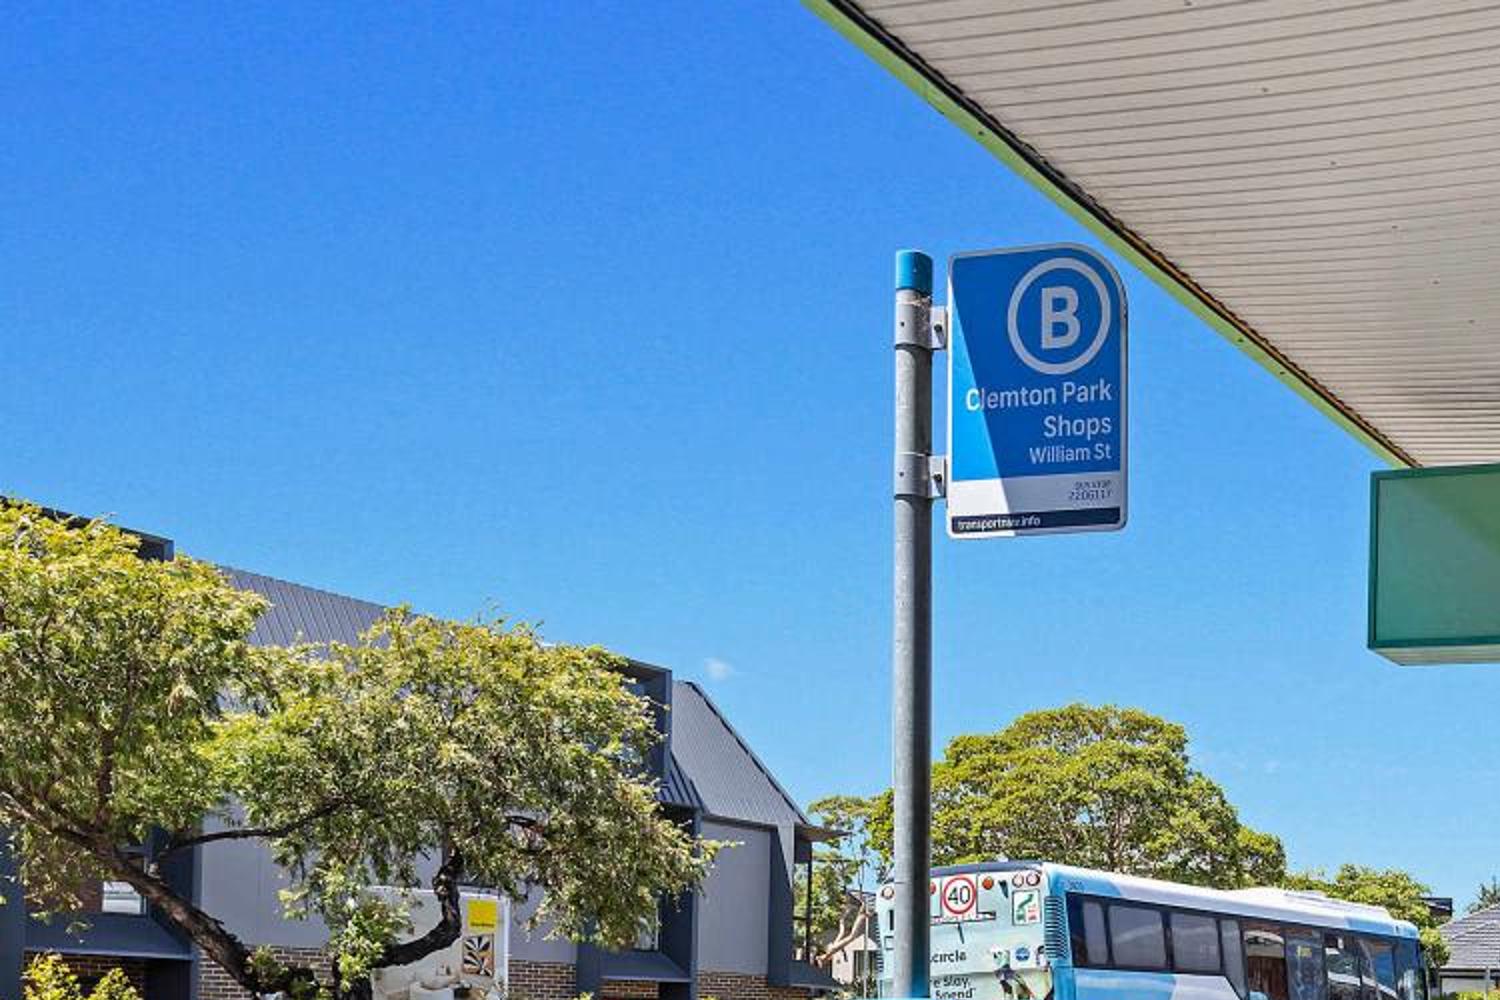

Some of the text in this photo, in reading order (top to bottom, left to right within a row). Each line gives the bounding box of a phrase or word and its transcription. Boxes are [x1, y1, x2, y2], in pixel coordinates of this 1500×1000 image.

[1041, 285, 1081, 350] B
[965, 379, 1112, 411] Clemton Park
[1044, 415, 1112, 440] Shops
[1029, 444, 1111, 465] William St
[948, 886, 971, 905] 40
[931, 949, 967, 963] circle
